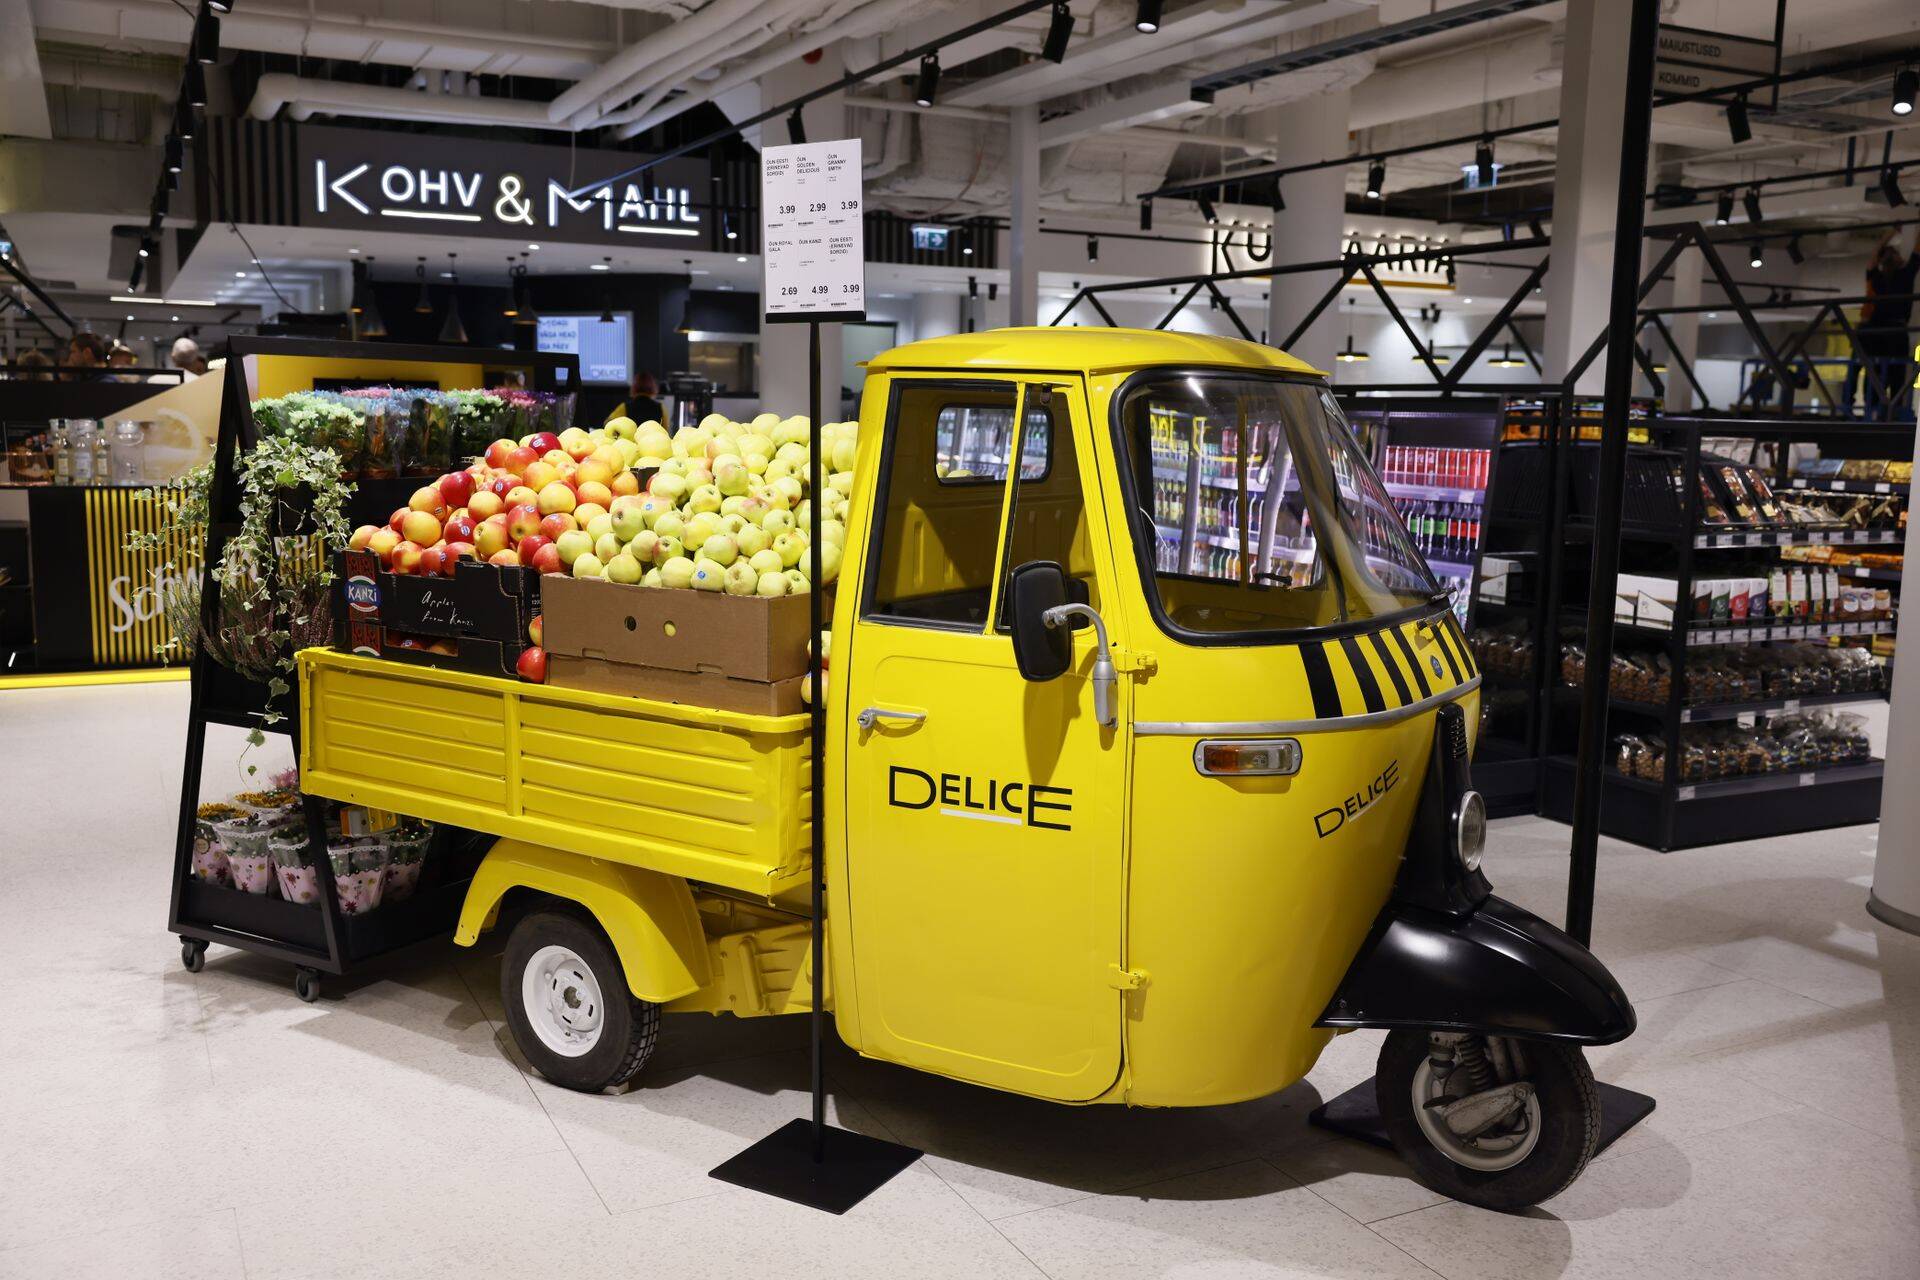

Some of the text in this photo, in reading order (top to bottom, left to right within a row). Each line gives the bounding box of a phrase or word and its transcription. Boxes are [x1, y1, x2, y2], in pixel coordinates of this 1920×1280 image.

[1659, 38, 1721, 57] MAIUSTUSED
[1658, 72, 1700, 87] KOMMID
[315, 159, 700, 230] KOHV & MAHL
[779, 205, 796, 214] 3.99
[809, 202, 827, 212] 2.99
[841, 200, 858, 210] 3.99
[781, 286, 798, 296] 2.69
[812, 285, 829, 294] 4.99
[843, 284, 860, 293] 3.99
[888, 765, 1073, 831] DELICE
[1313, 759, 1400, 838] DELICE
